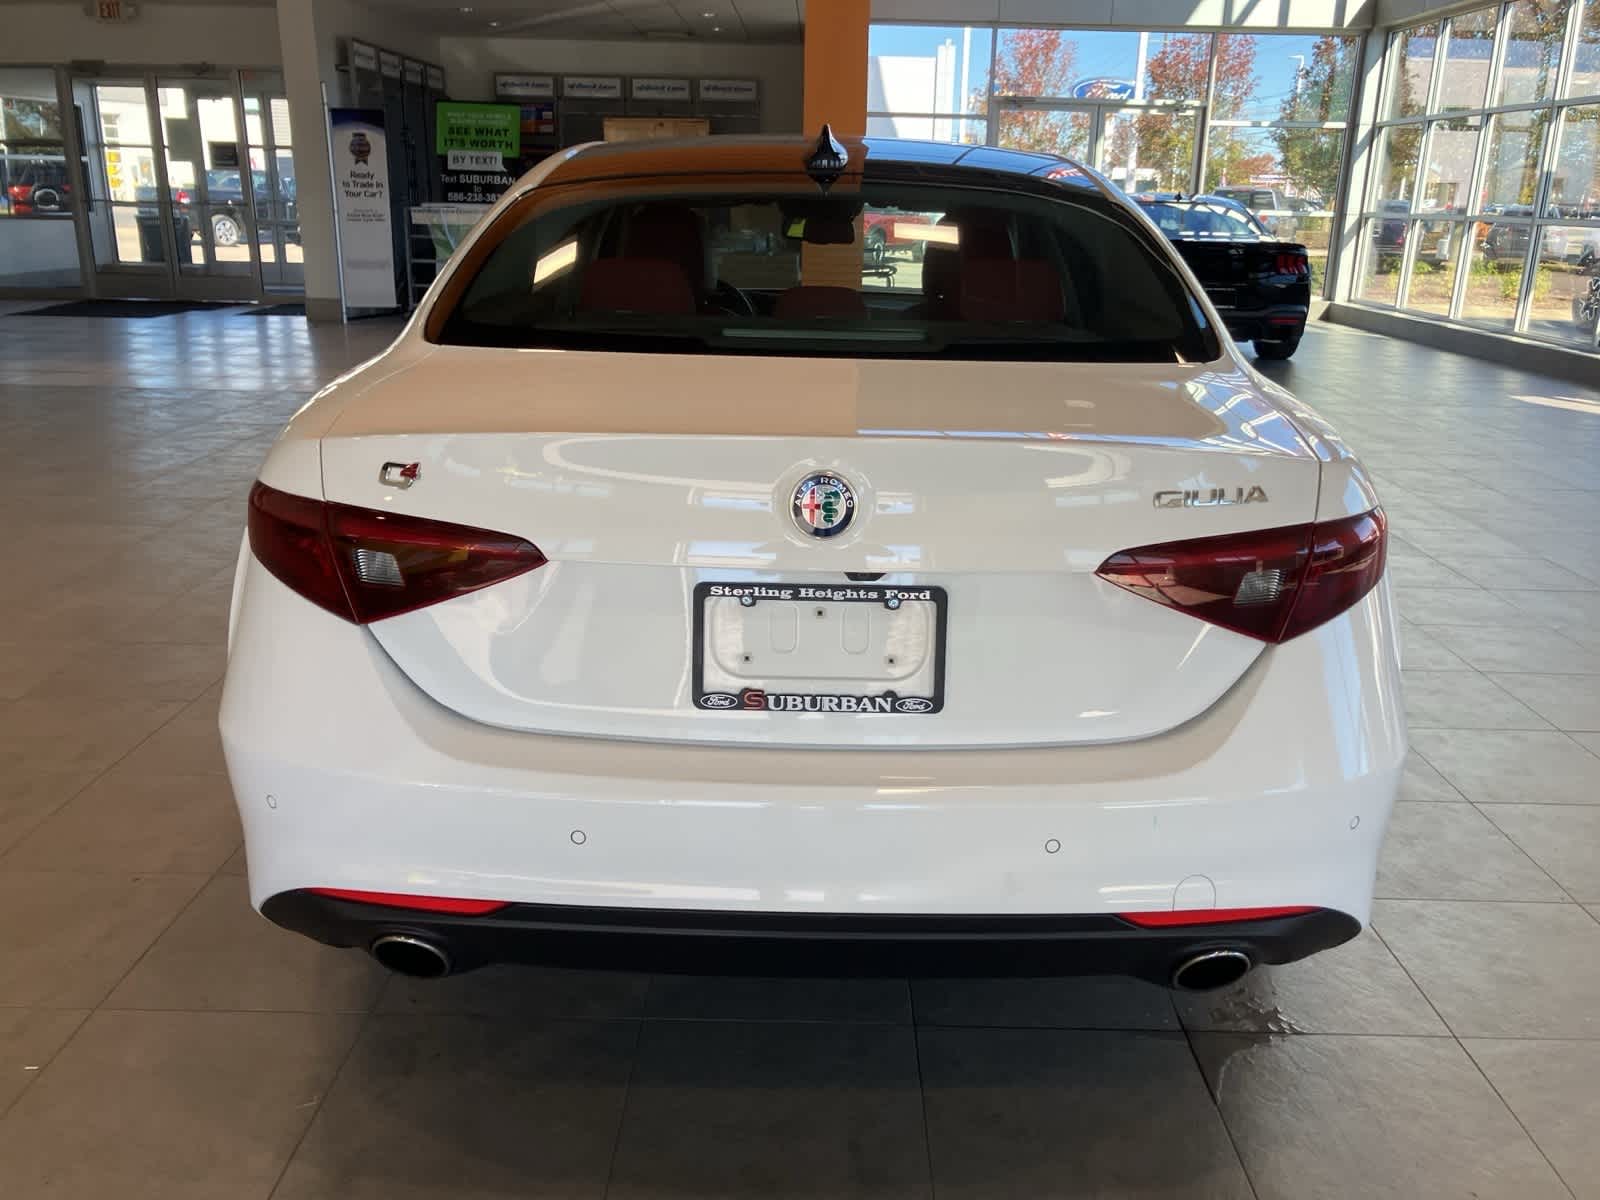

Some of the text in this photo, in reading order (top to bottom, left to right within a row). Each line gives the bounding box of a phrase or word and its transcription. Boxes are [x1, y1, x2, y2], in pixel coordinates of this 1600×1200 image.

[99, 1, 120, 19] EXIT
[447, 127, 510, 138] SEE WHAT
[471, 139, 513, 150] WORTH
[452, 155, 466, 165] BY
[350, 170, 375, 181] Ready
[440, 175, 457, 185] Text
[342, 181, 350, 189] to
[352, 181, 374, 190] Trade
[344, 189, 362, 198] Your
[794, 477, 854, 507] ALFA ROMEO
[1153, 485, 1269, 508] GIULIA
[710, 586, 931, 600] Sterling Heights Ford
[705, 690, 928, 713] Ford SUBURBAN Ford
